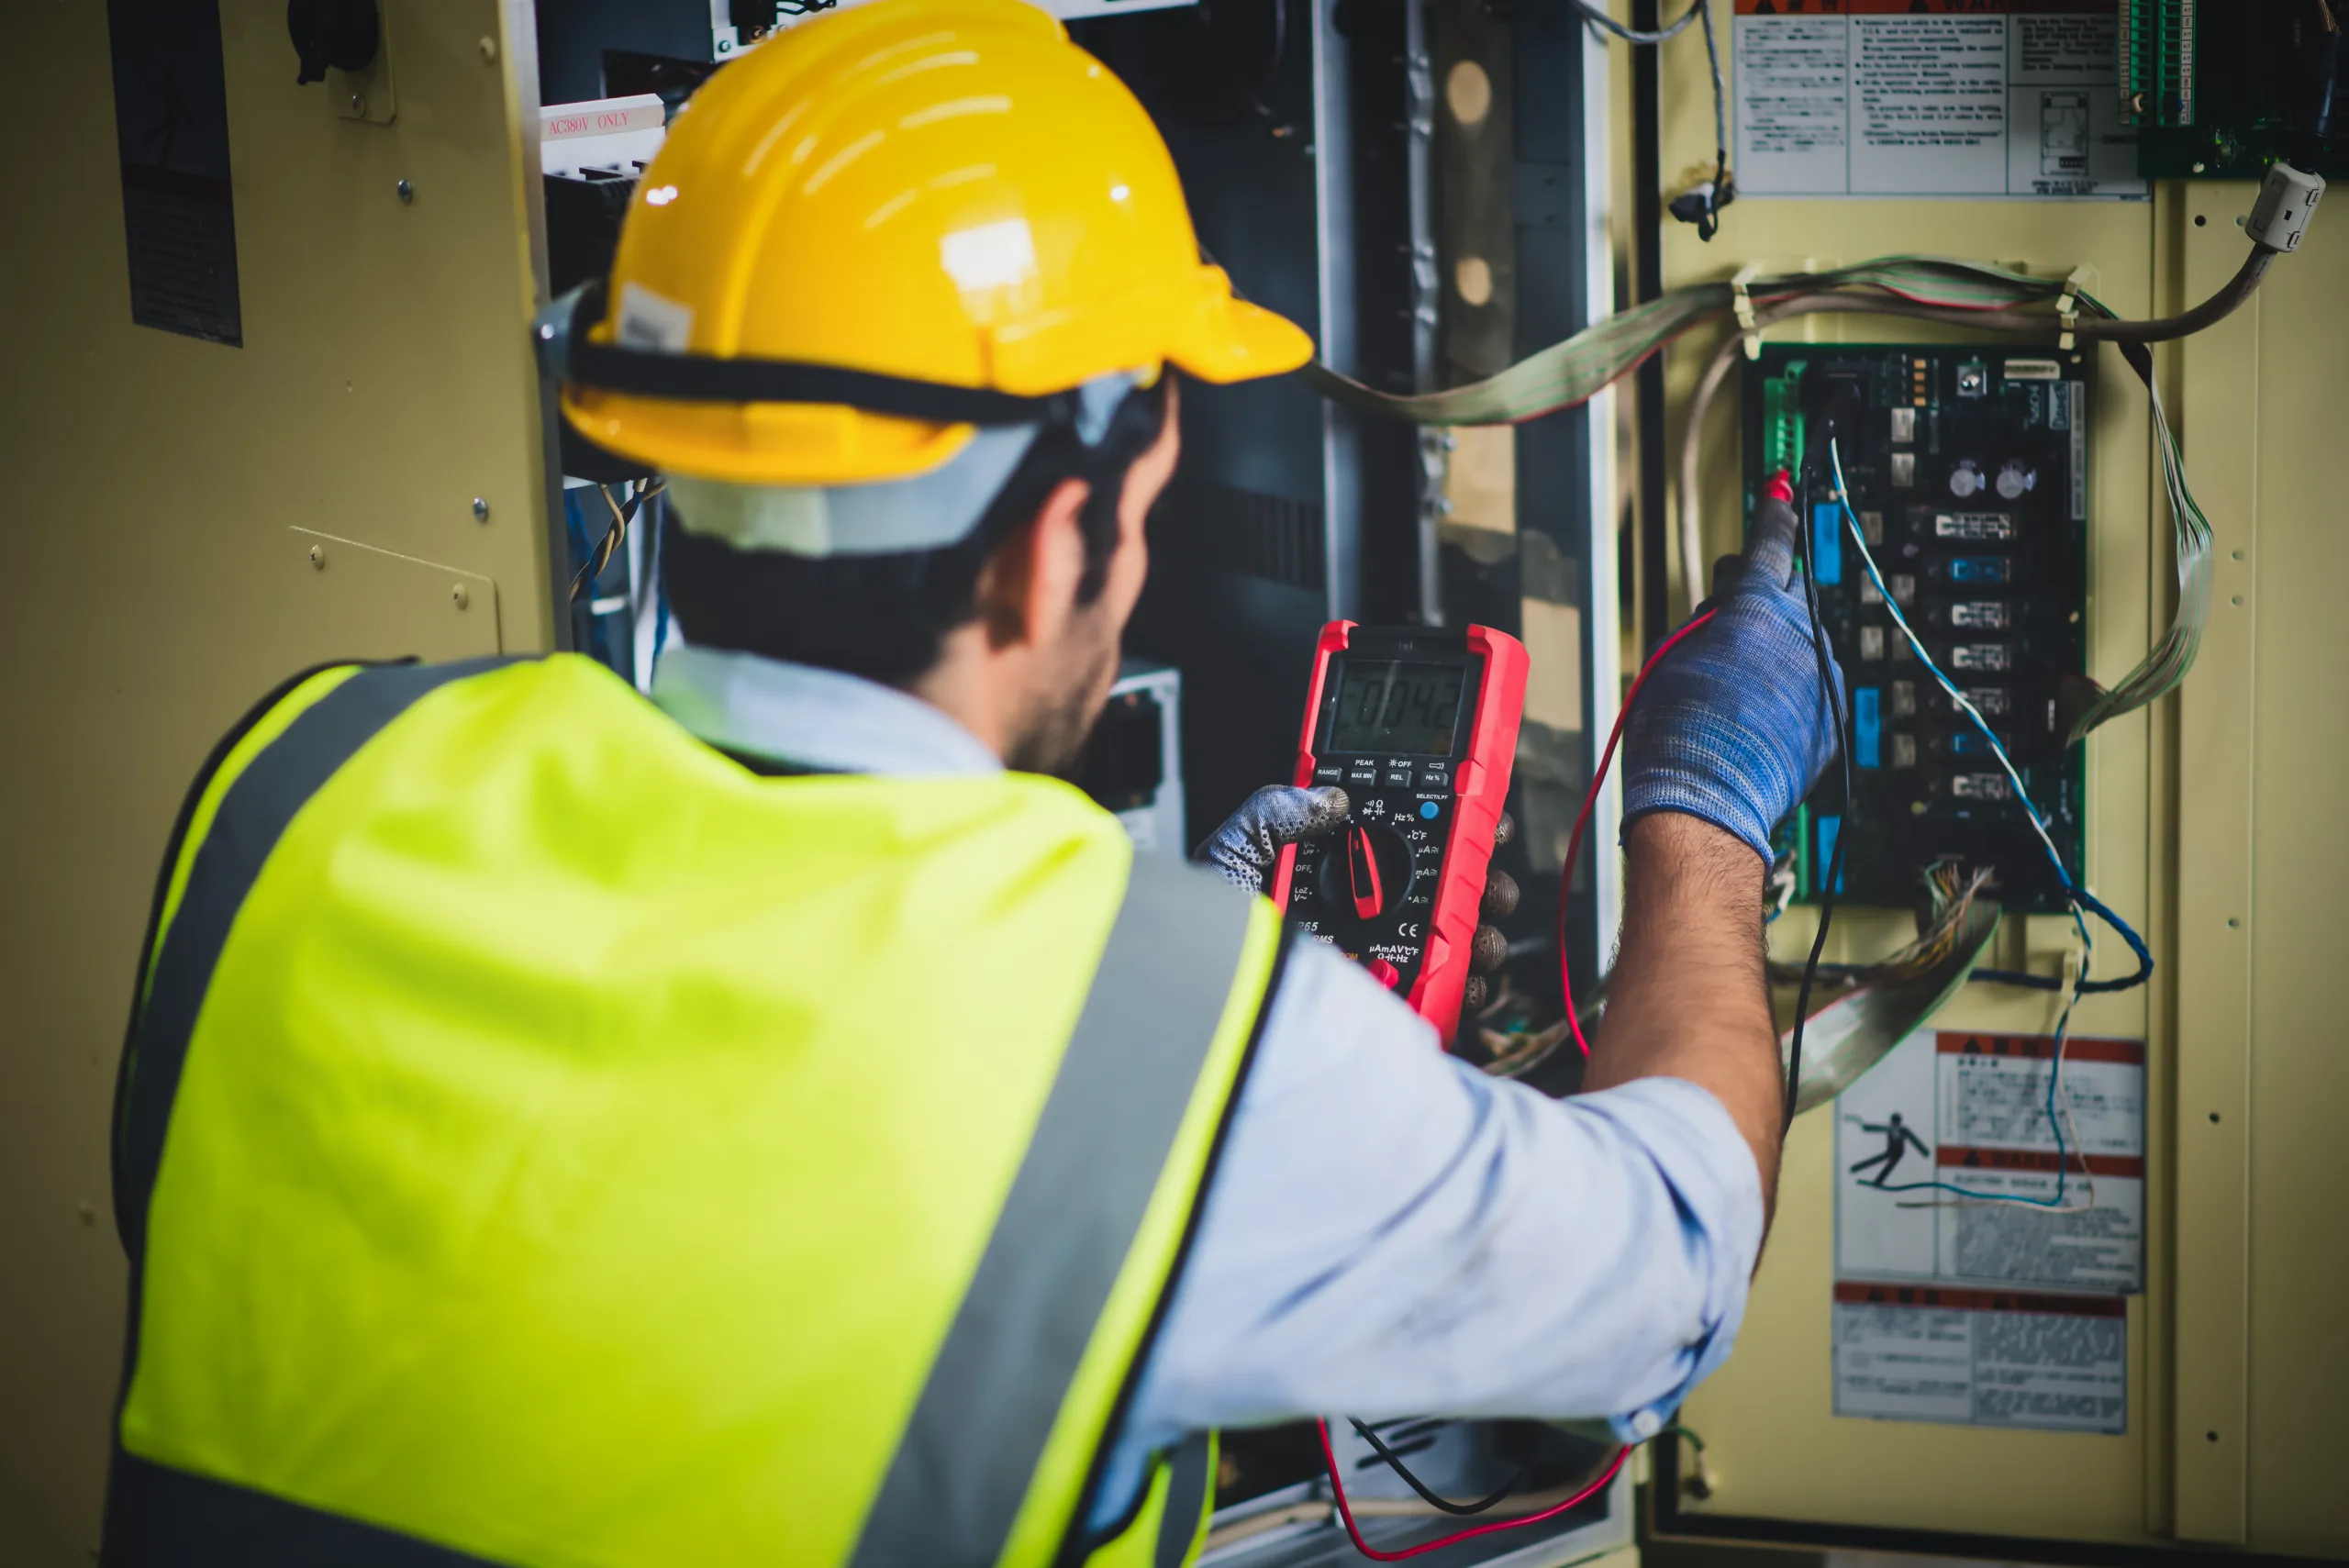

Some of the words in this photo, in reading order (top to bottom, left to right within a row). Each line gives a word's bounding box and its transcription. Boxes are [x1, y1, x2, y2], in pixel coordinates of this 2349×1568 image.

[549, 117, 589, 135] AC380V
[597, 111, 629, 129] ONLY
[1354, 759, 1375, 767] PEAK
[1317, 768, 1339, 776] RANGE
[1398, 922, 1419, 938] CE
